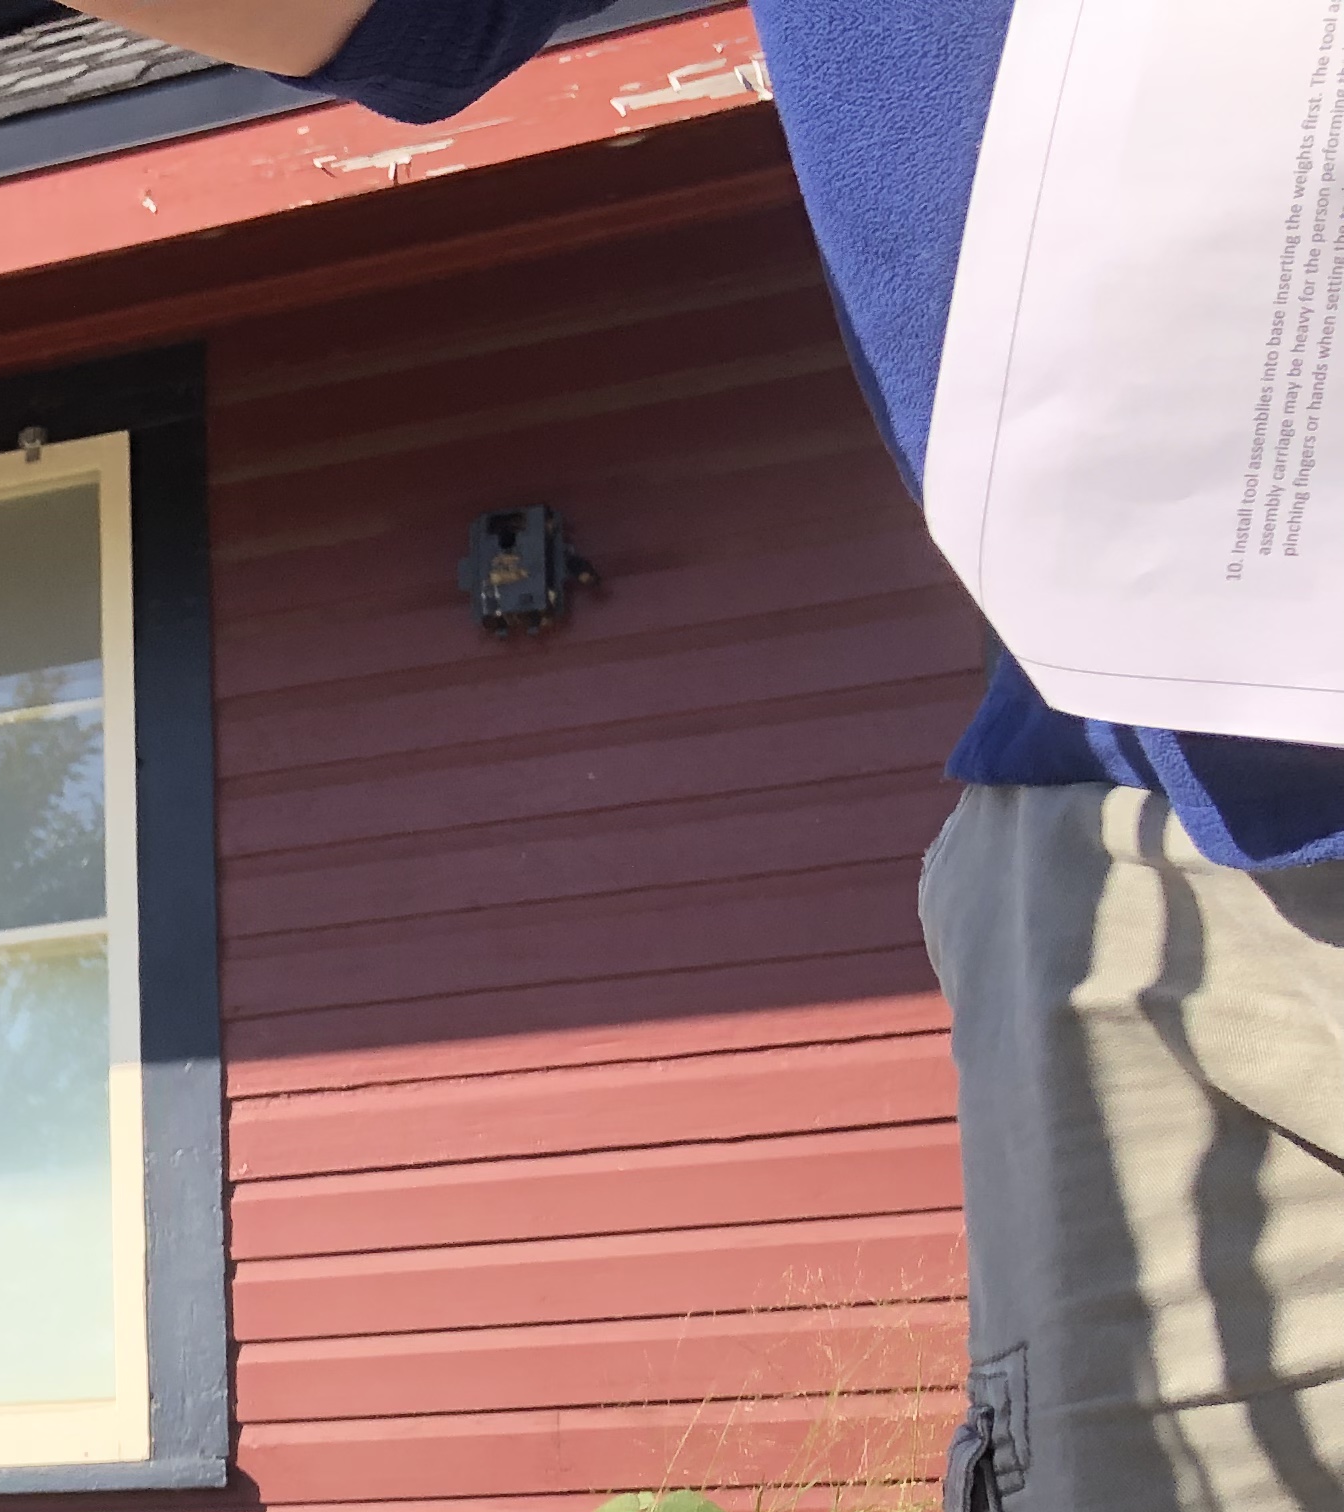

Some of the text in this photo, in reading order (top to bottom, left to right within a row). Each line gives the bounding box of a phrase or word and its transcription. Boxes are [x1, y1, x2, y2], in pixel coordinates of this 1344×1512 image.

[1318, 18, 1337, 51] tool
[1310, 57, 1330, 87] The
[1301, 93, 1322, 129] first.
[1293, 135, 1314, 199] weights
[1285, 204, 1302, 230] the
[1311, 188, 1330, 243] person
[1273, 236, 1301, 304] inserting
[1303, 248, 1321, 273] the
[1298, 280, 1316, 302] for
[1325, 256, 1344, 310] setting
[1266, 310, 1286, 346] base
[1290, 307, 1315, 352] heavy
[1316, 316, 1336, 359] when
[1260, 351, 1279, 381] into
[1287, 358, 1303, 376] be
[1283, 381, 1303, 413] may
[1305, 364, 1328, 410] hands
[1247, 386, 1273, 469] assemblies
[1305, 416, 1320, 431] or
[1272, 419, 1295, 480] carriage
[1292, 436, 1315, 487] fingers
[1240, 474, 1259, 504] tool
[1231, 509, 1254, 553] Install
[1258, 485, 1286, 556] assembly
[1282, 492, 1311, 557] pinching
[1226, 560, 1244, 581] 10.
